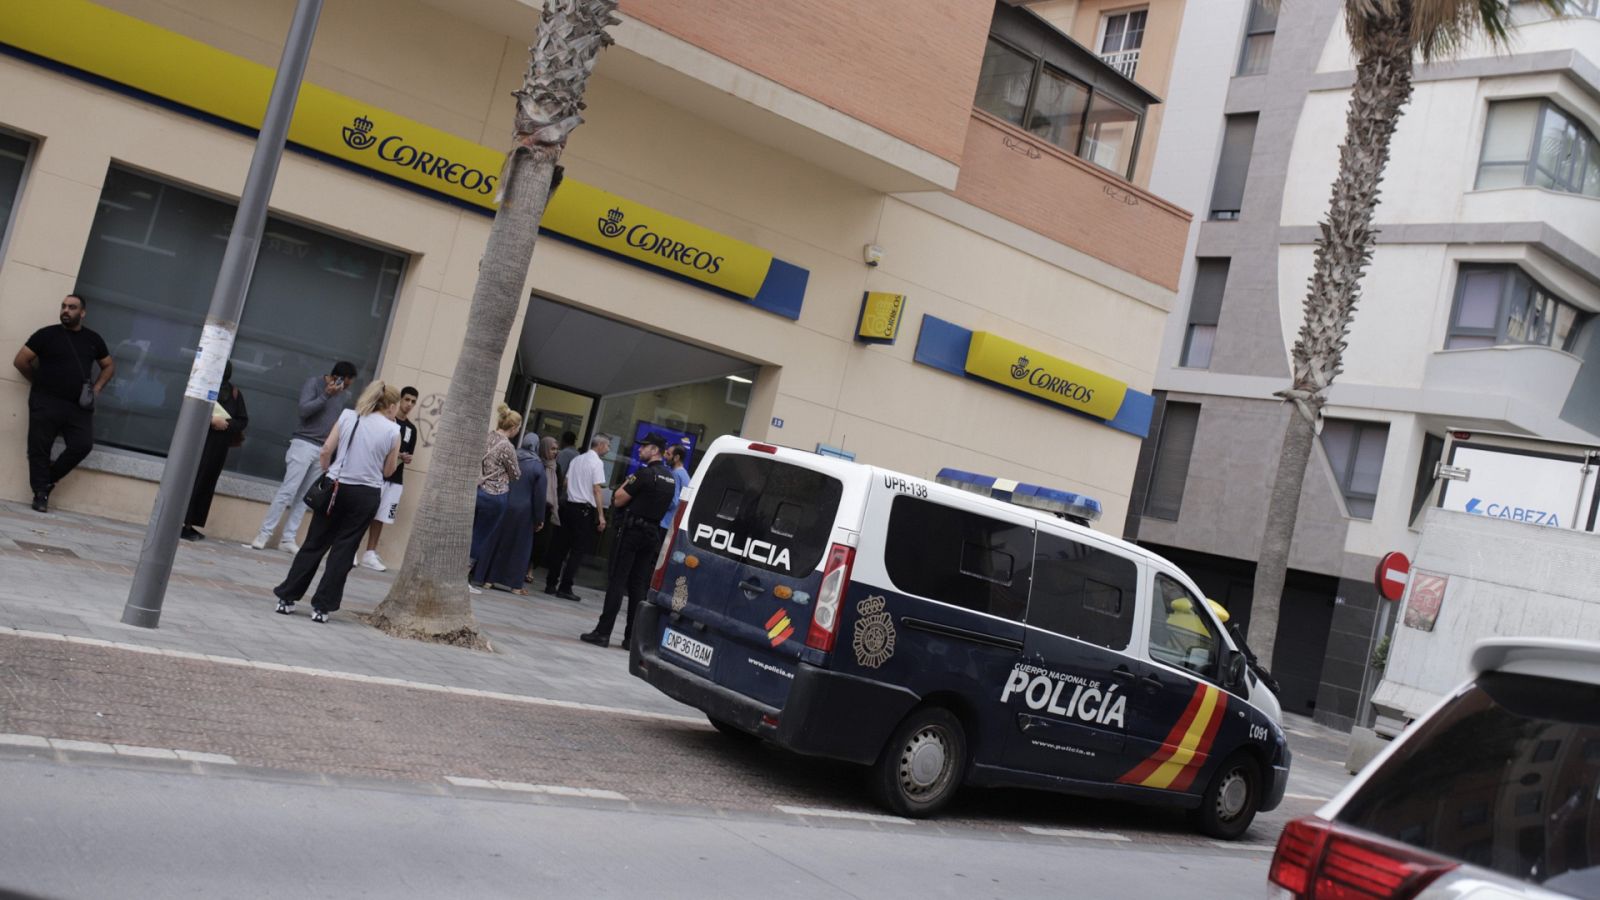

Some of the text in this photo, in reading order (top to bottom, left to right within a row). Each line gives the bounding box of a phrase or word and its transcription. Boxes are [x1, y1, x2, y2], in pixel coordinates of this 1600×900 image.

[377, 136, 498, 195] CORREOS
[626, 224, 725, 274] CORREOS
[1028, 367, 1095, 404] CORREOS
[884, 474, 928, 498] UPR-138
[1486, 503, 1559, 528] CABEZA
[693, 523, 791, 571] POLICIA
[748, 657, 795, 679] www.policia.es
[1014, 662, 1101, 689] CUERPO NACIONAL DE
[1000, 669, 1127, 729] POLICÍA
[1253, 725, 1268, 741] 091
